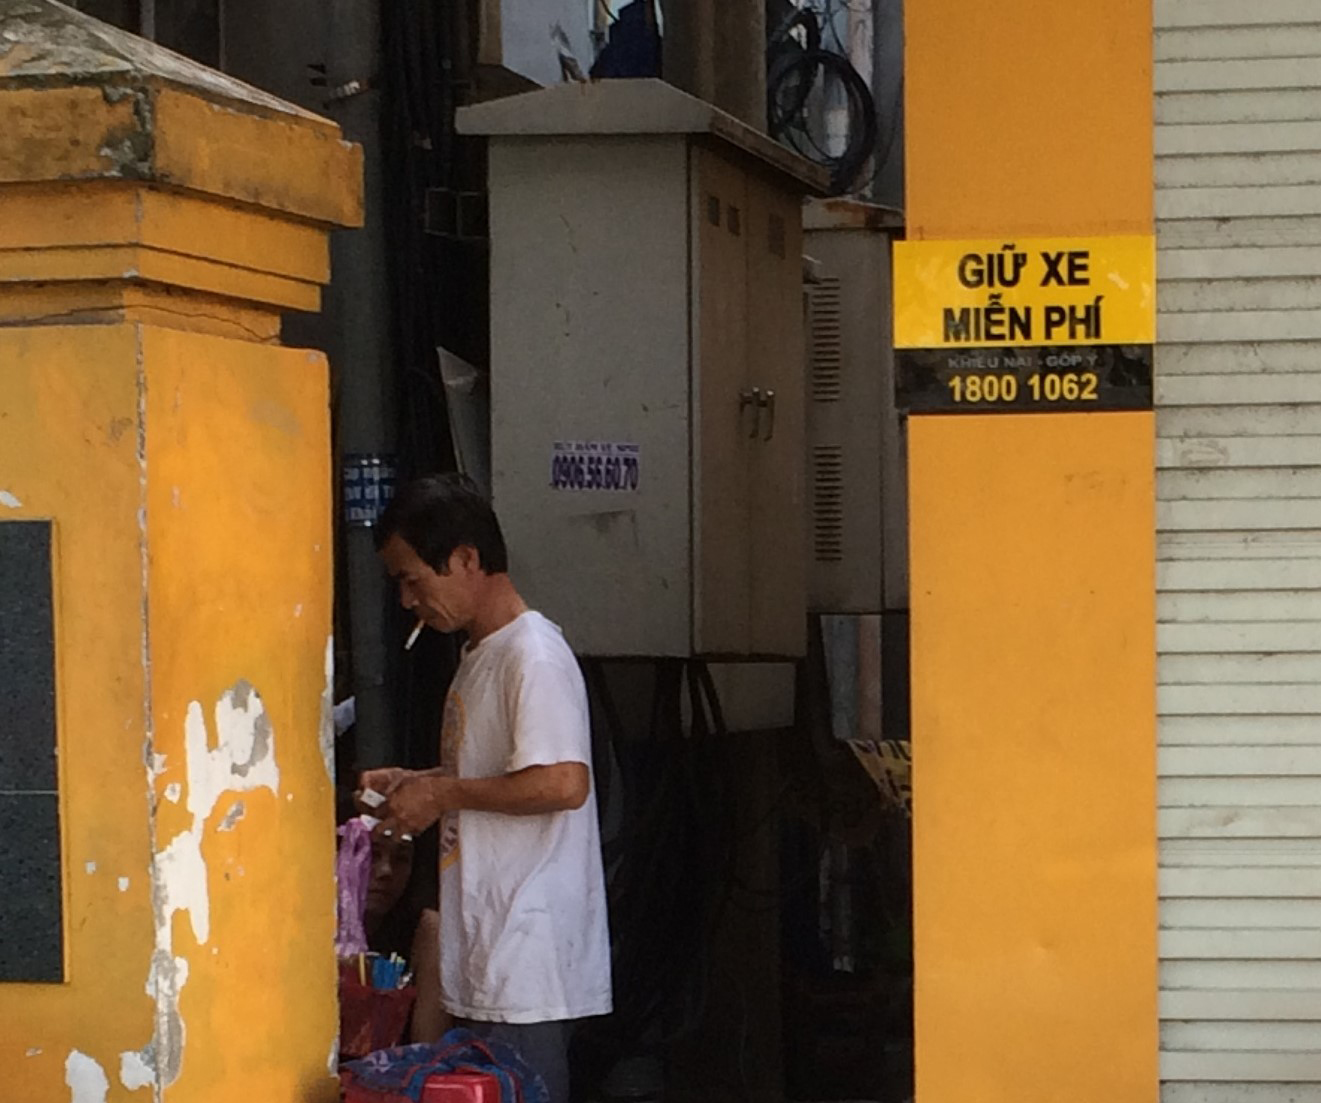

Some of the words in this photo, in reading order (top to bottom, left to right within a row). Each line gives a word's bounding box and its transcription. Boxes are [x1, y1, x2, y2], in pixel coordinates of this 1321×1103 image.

[957, 243, 1028, 289] GIỮ
[1040, 251, 1090, 287] XE
[943, 292, 1032, 342] MIỄN
[1044, 294, 1105, 341] PHÍ
[948, 374, 1018, 402] 1800
[1028, 372, 1099, 401] 1062
